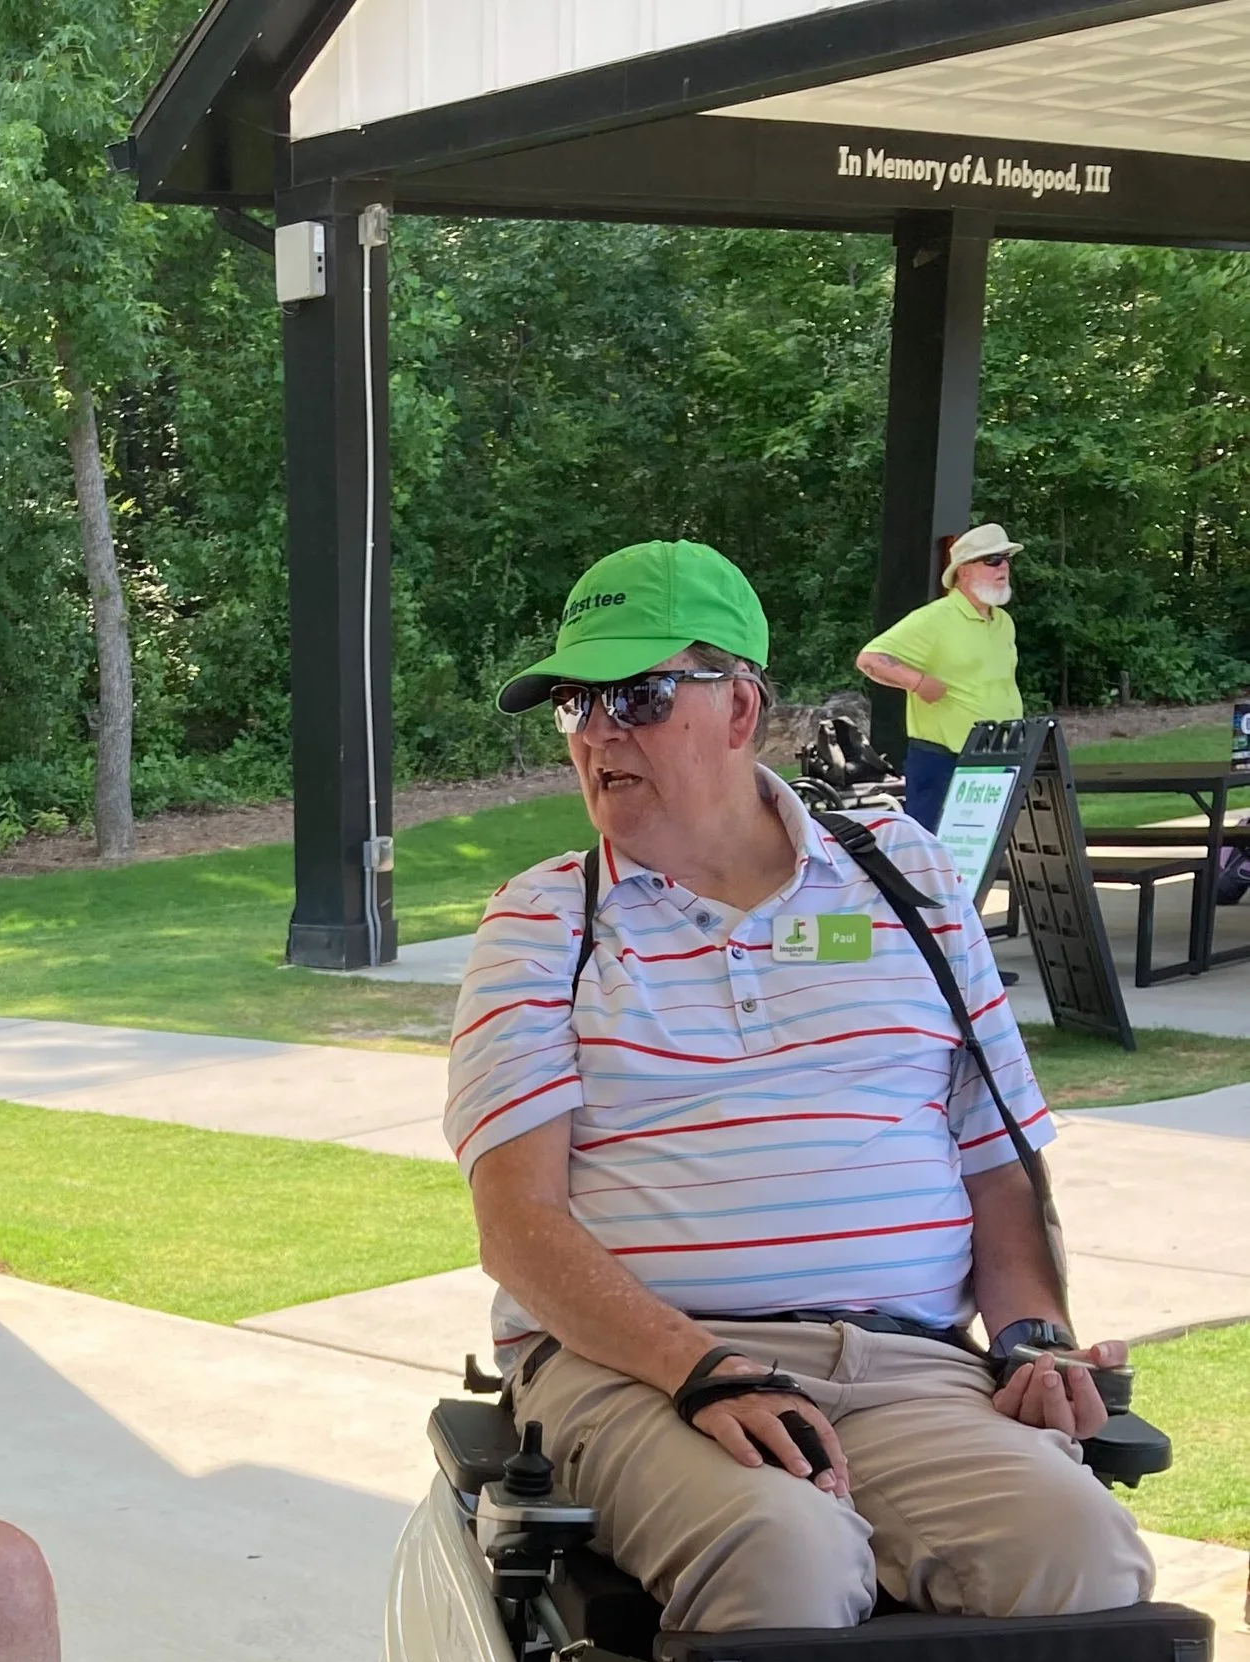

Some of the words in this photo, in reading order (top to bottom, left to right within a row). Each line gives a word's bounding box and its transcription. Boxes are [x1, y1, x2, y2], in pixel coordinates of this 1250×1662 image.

[838, 146, 861, 176] In
[866, 147, 947, 191] Memory
[949, 154, 972, 184] of
[972, 157, 993, 186] A.
[996, 158, 1082, 198] Hobgood,
[1085, 164, 1112, 193] III
[595, 592, 626, 607] tee
[964, 780, 985, 804] first
[983, 784, 1002, 804] tee
[833, 932, 856, 943] Paul
[779, 945, 814, 953] Inspiration
